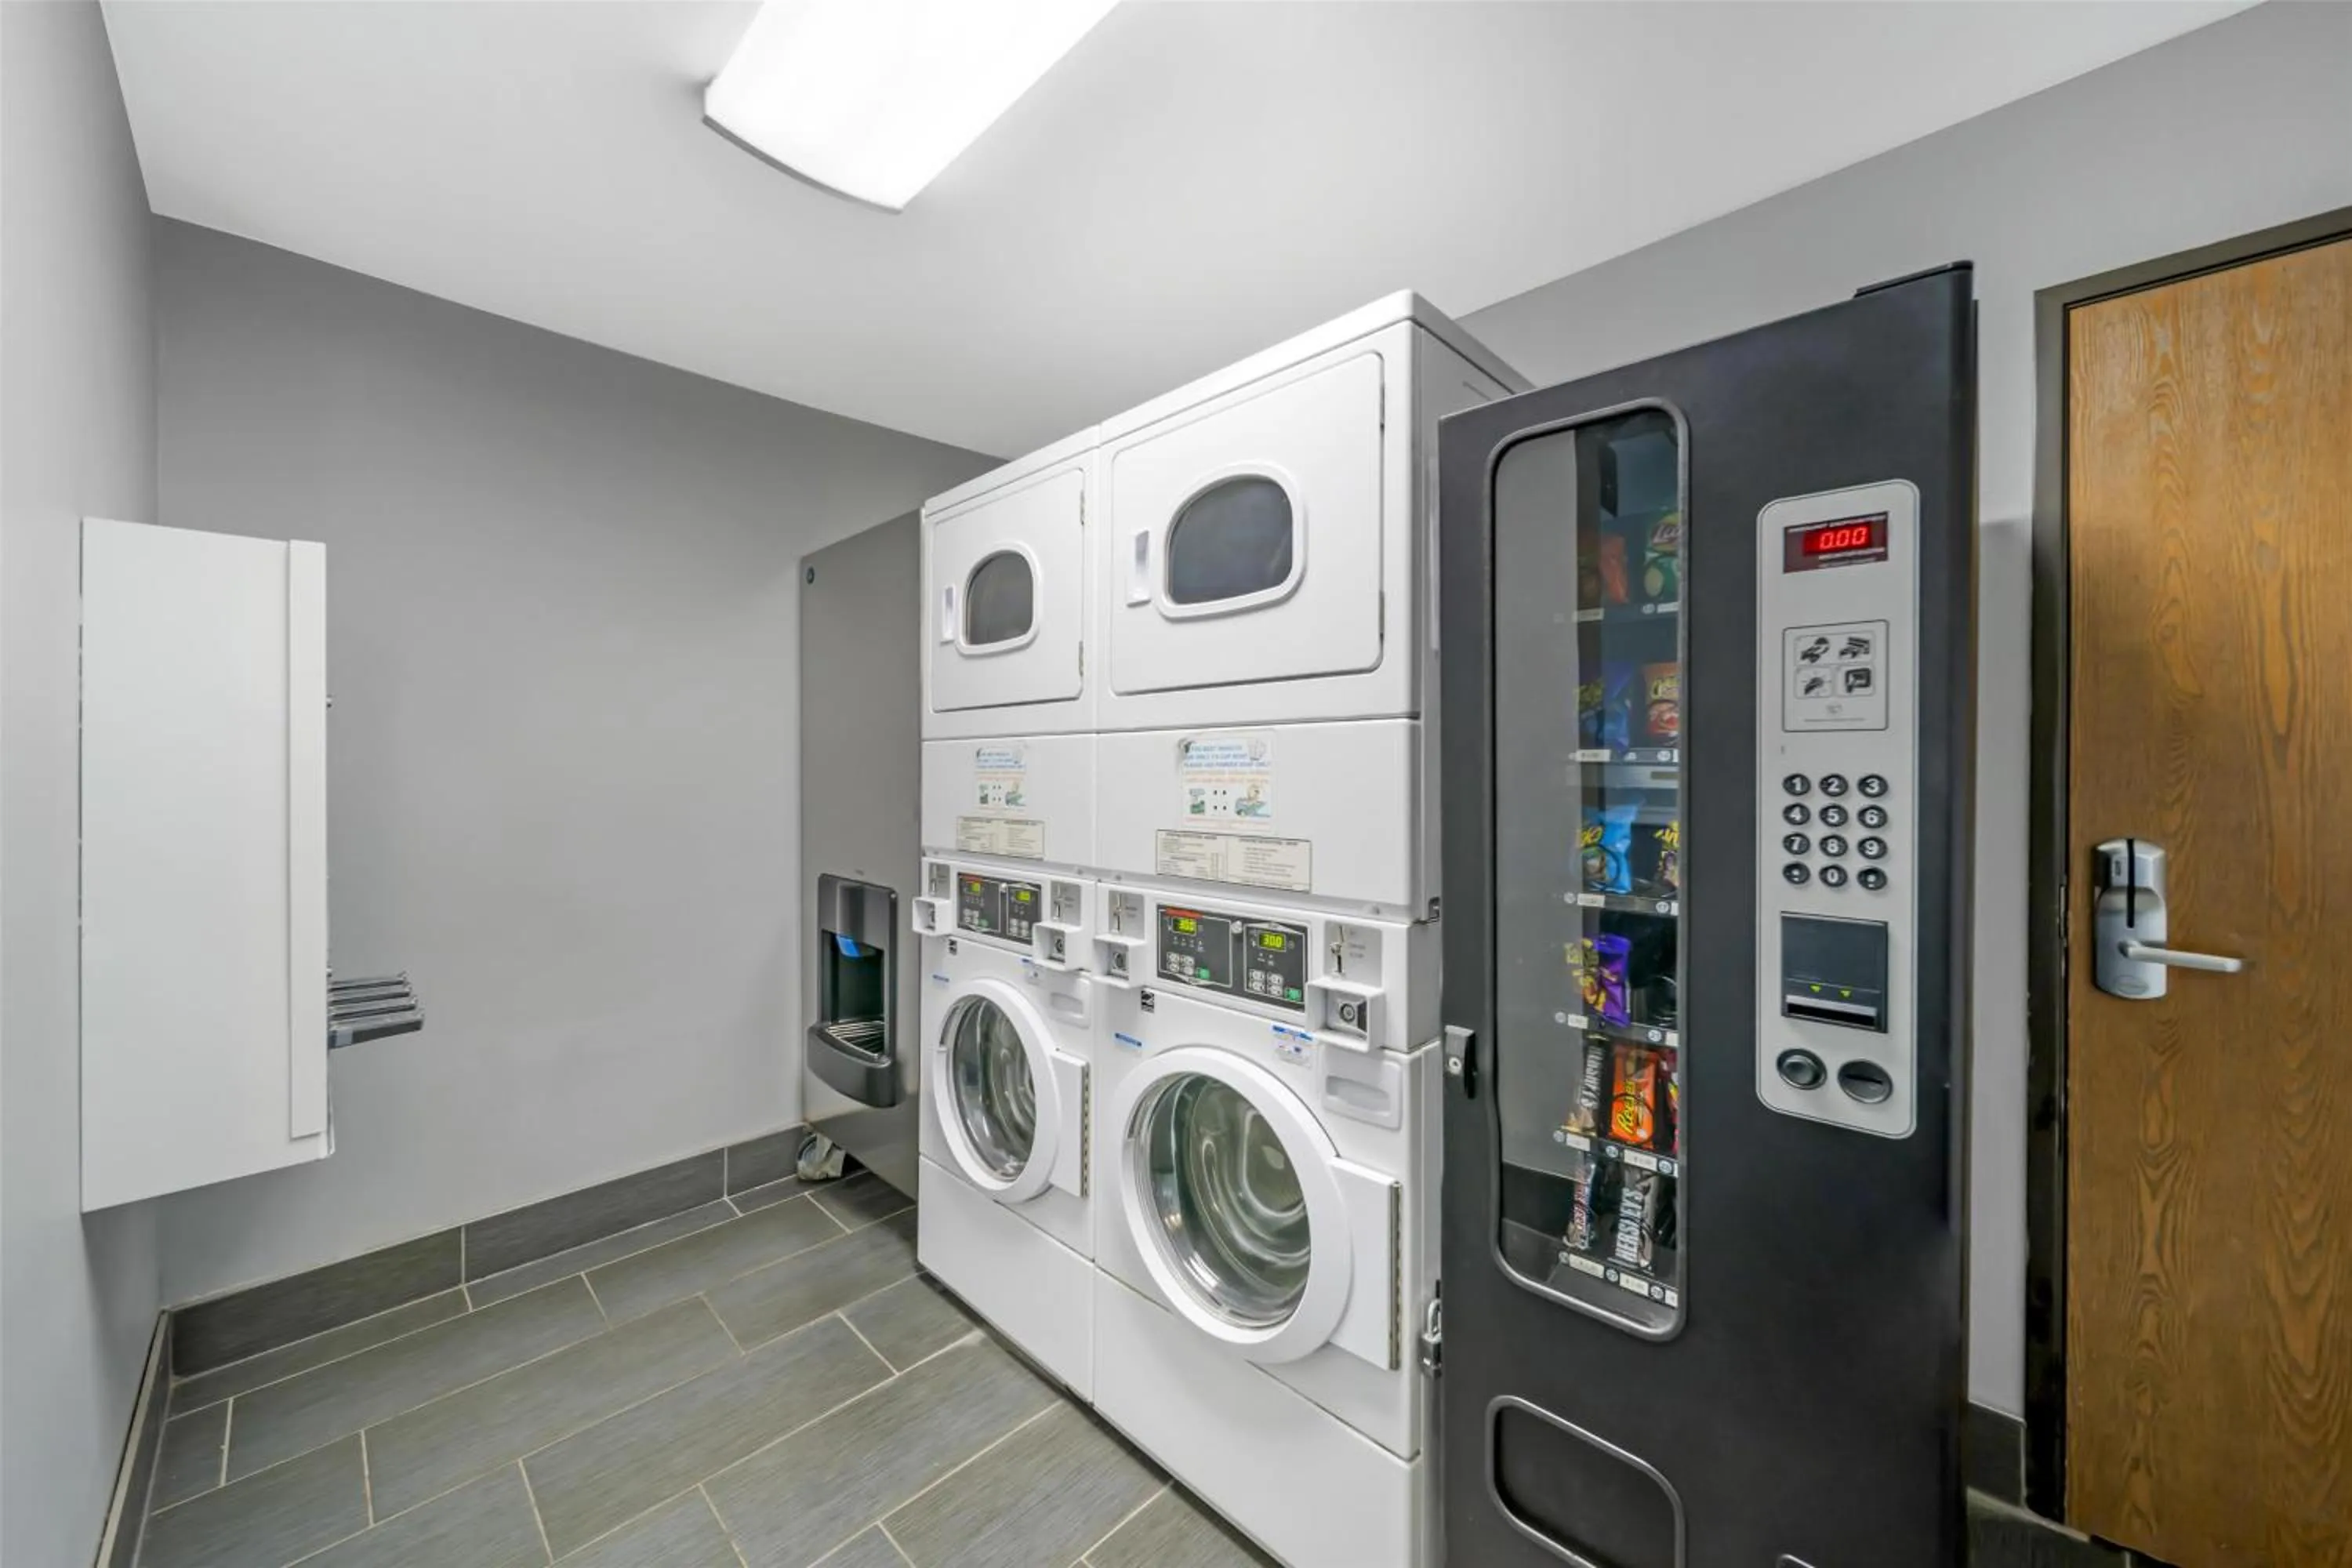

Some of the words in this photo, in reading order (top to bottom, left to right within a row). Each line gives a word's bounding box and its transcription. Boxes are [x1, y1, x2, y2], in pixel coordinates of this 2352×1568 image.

[1819, 526, 1868, 550] 0.00
[1792, 777, 1802, 792] 1
[1828, 778, 1840, 793] 2
[1865, 778, 1880, 793] 3
[1790, 807, 1802, 821] 4
[1827, 808, 1839, 823] 5
[1865, 809, 1879, 825] 6
[1790, 837, 1802, 851] 7
[1827, 838, 1839, 853] 8
[1865, 840, 1879, 855] 9
[1827, 869, 1839, 884] 0
